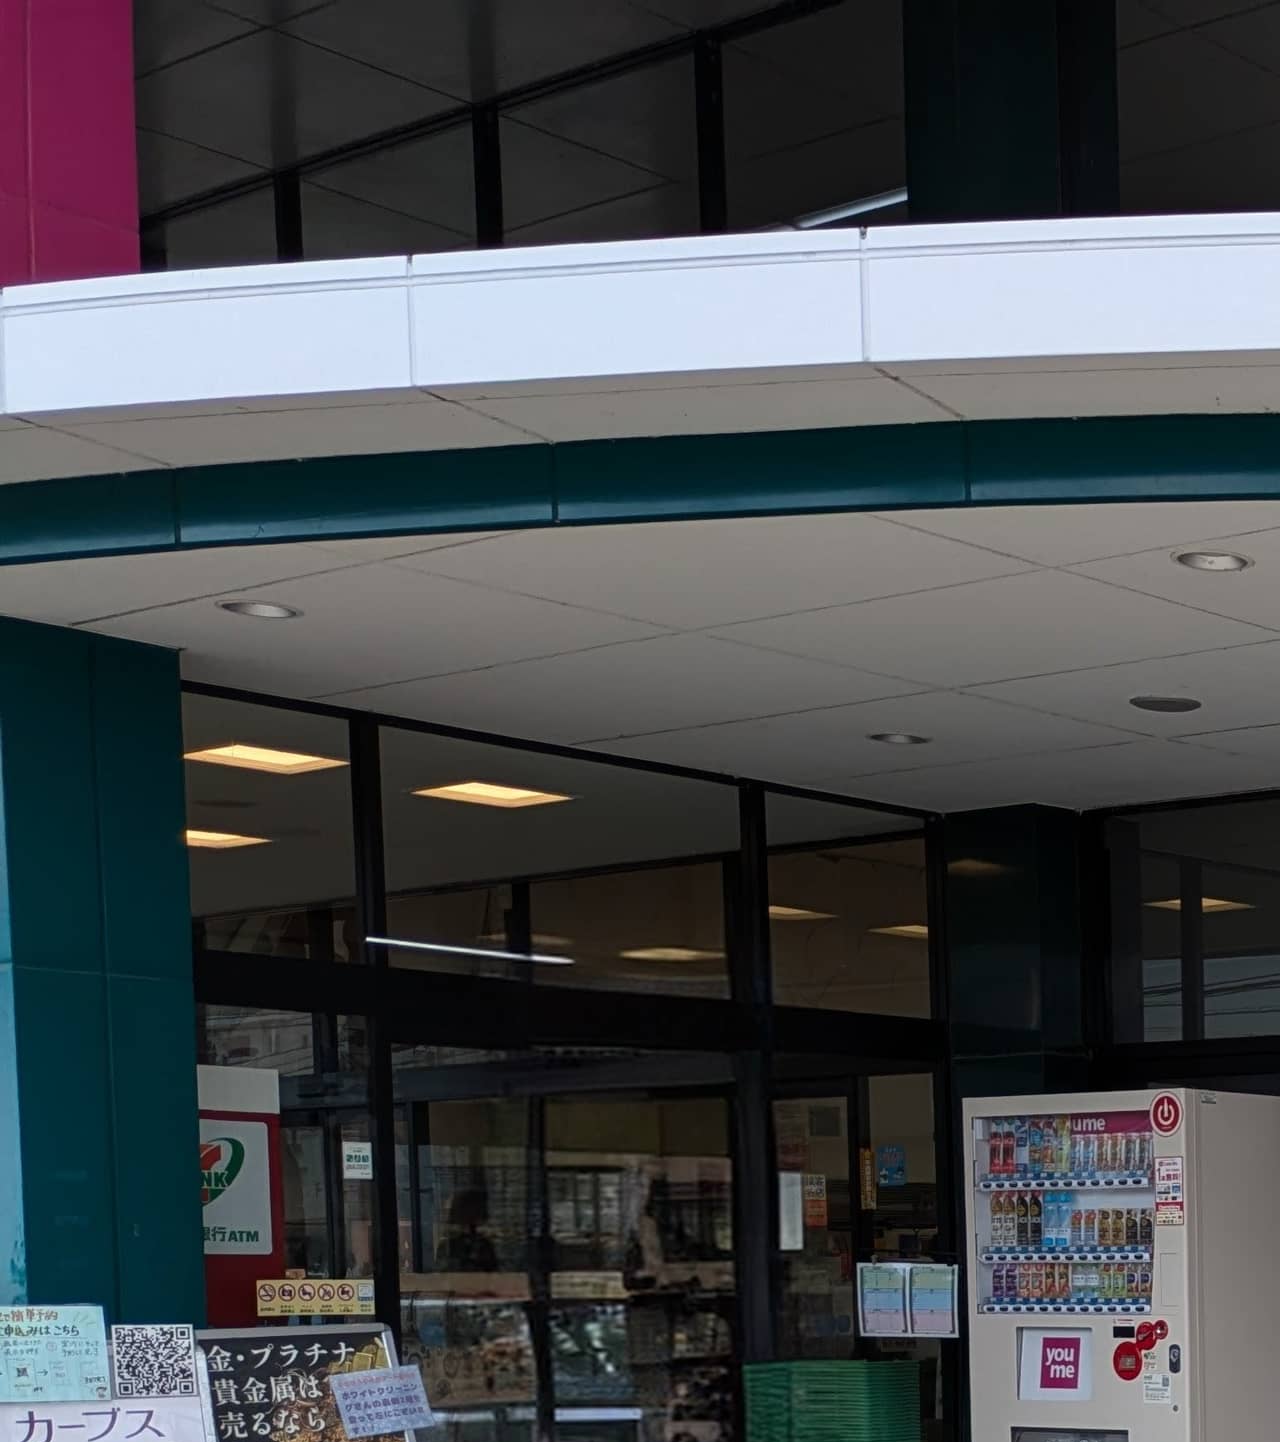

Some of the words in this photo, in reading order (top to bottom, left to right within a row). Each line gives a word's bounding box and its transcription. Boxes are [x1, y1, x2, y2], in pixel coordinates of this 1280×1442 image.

[206, 1342, 356, 1373] 金・プラチナ
[1046, 1347, 1074, 1365] you
[1050, 1364, 1075, 1379] me
[212, 1374, 324, 1406] 貴金属は
[218, 1407, 326, 1439] 売るなら
